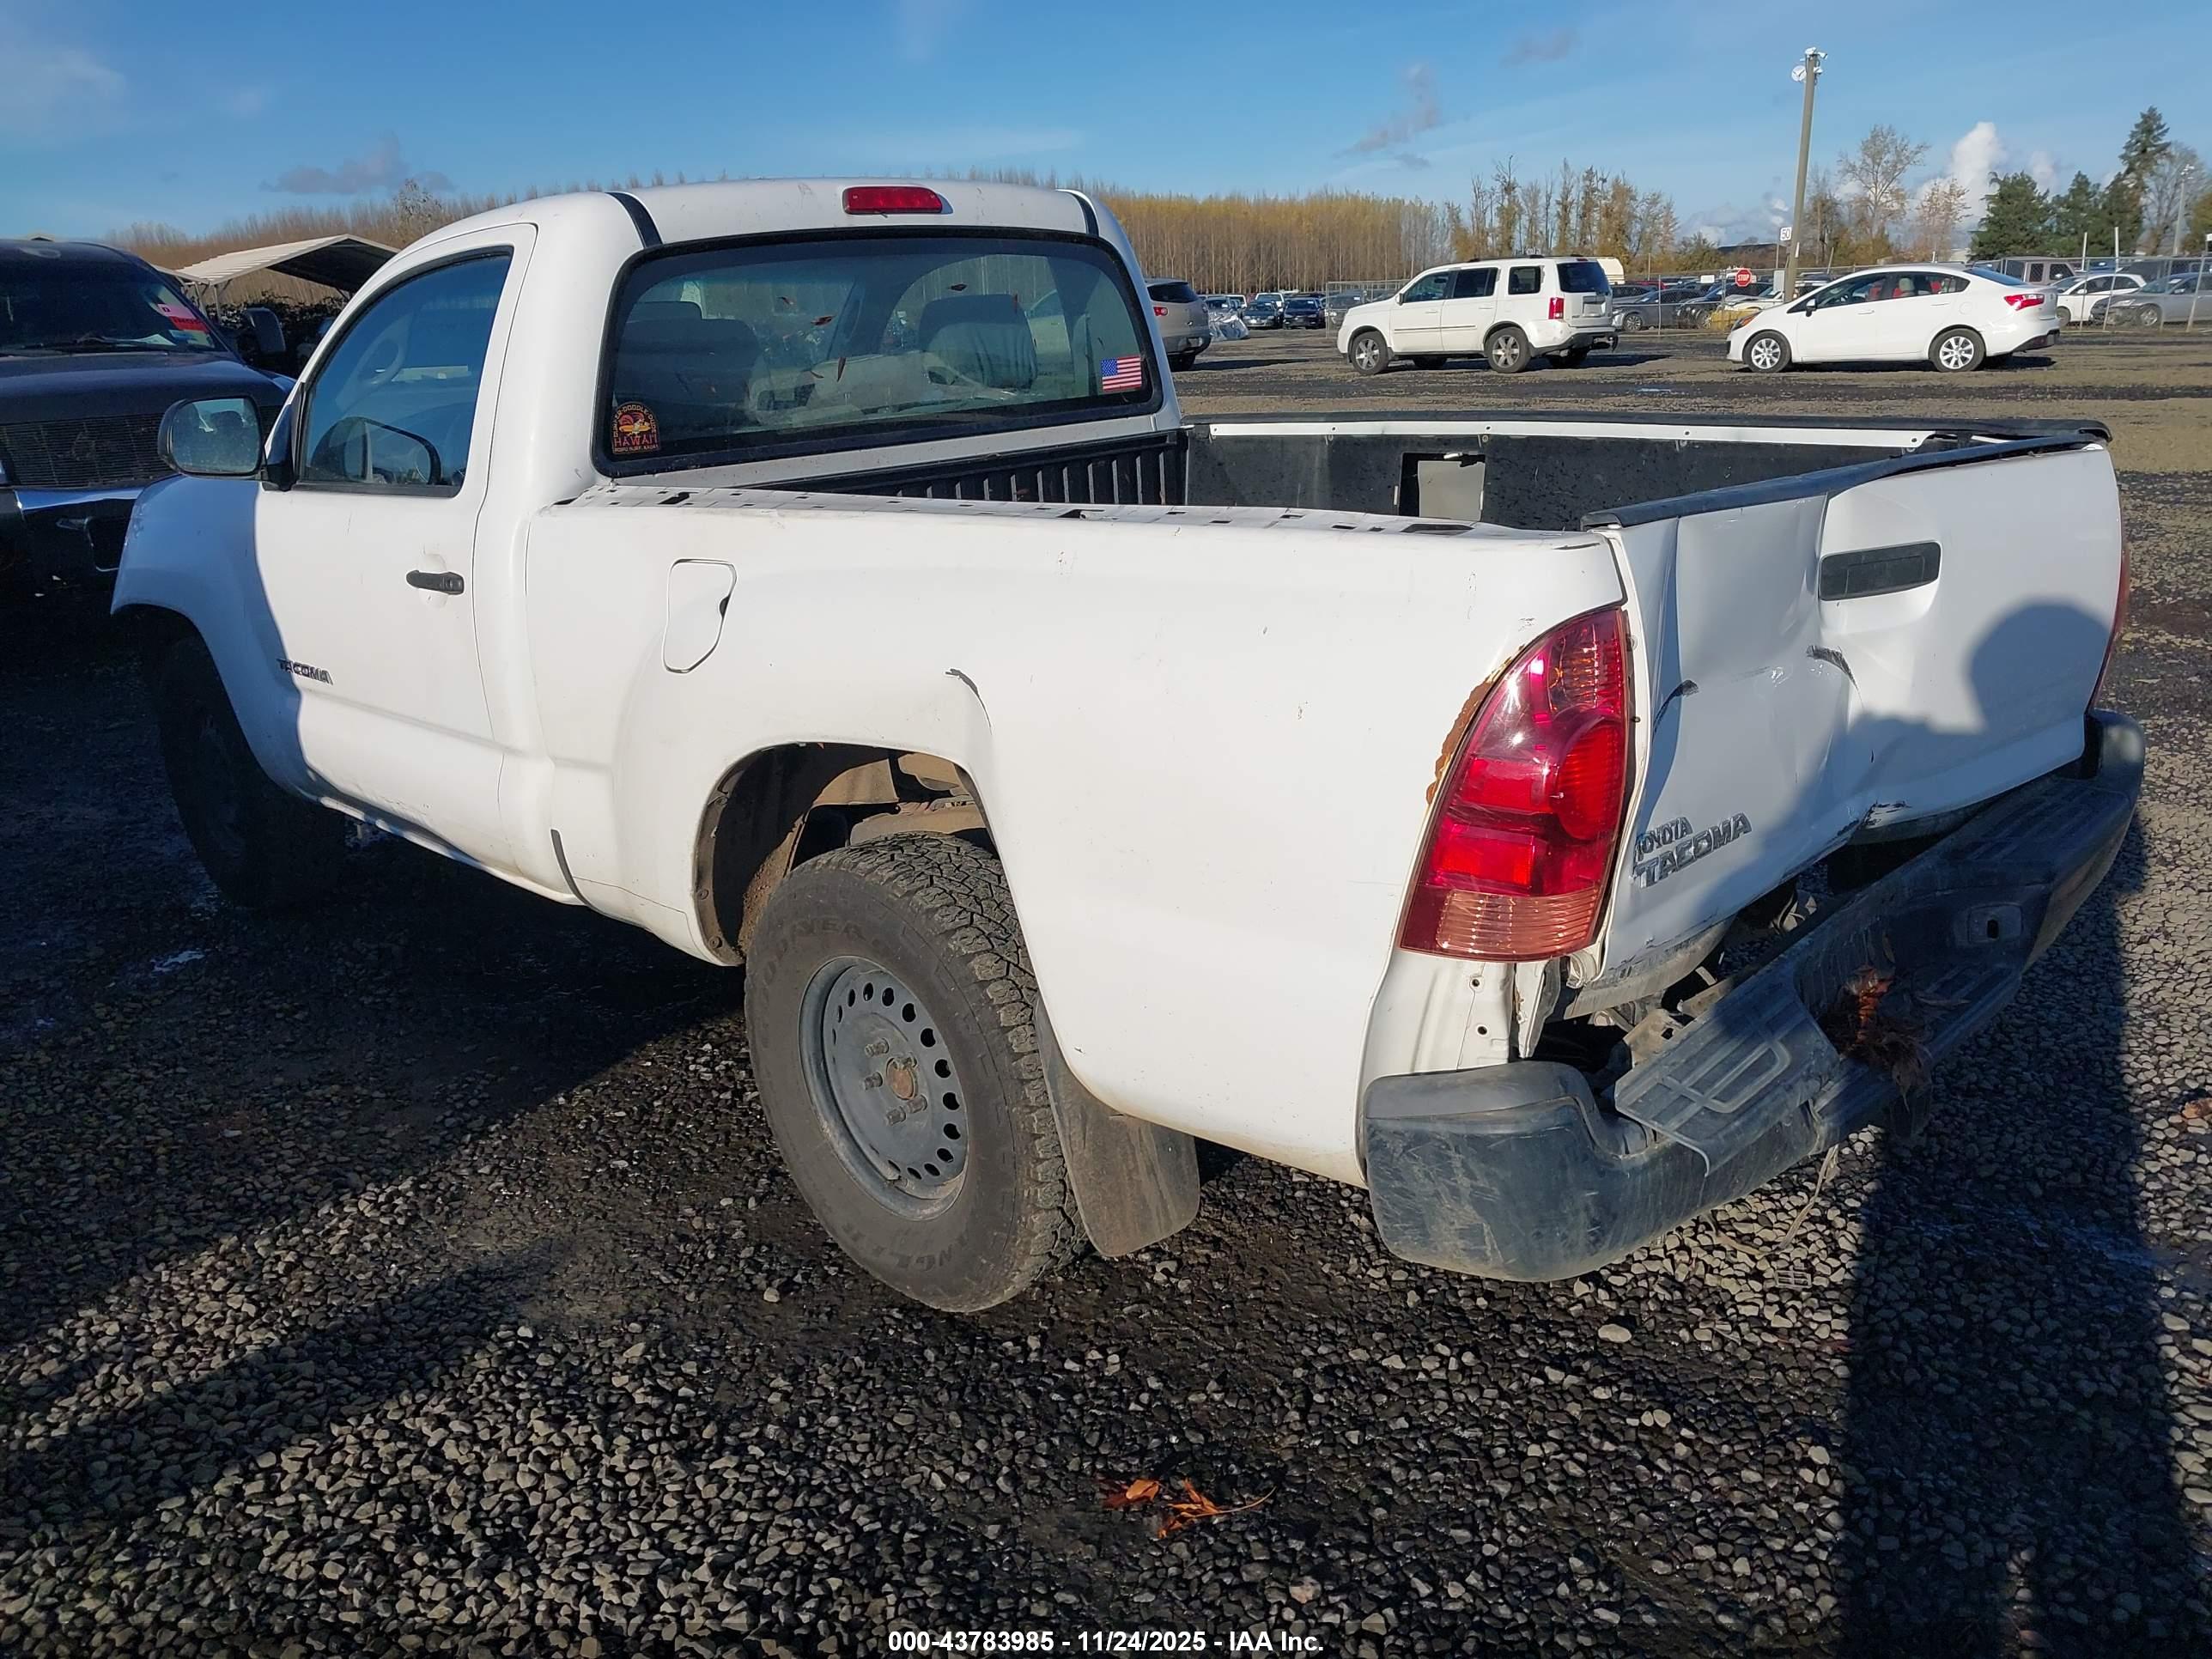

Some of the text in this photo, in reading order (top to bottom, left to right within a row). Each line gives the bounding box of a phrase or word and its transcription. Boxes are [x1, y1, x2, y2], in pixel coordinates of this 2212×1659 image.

[276, 658, 334, 685] TACOMA
[1633, 812, 1753, 889] TACOMA
[1634, 817, 1693, 861] TOYOTA
